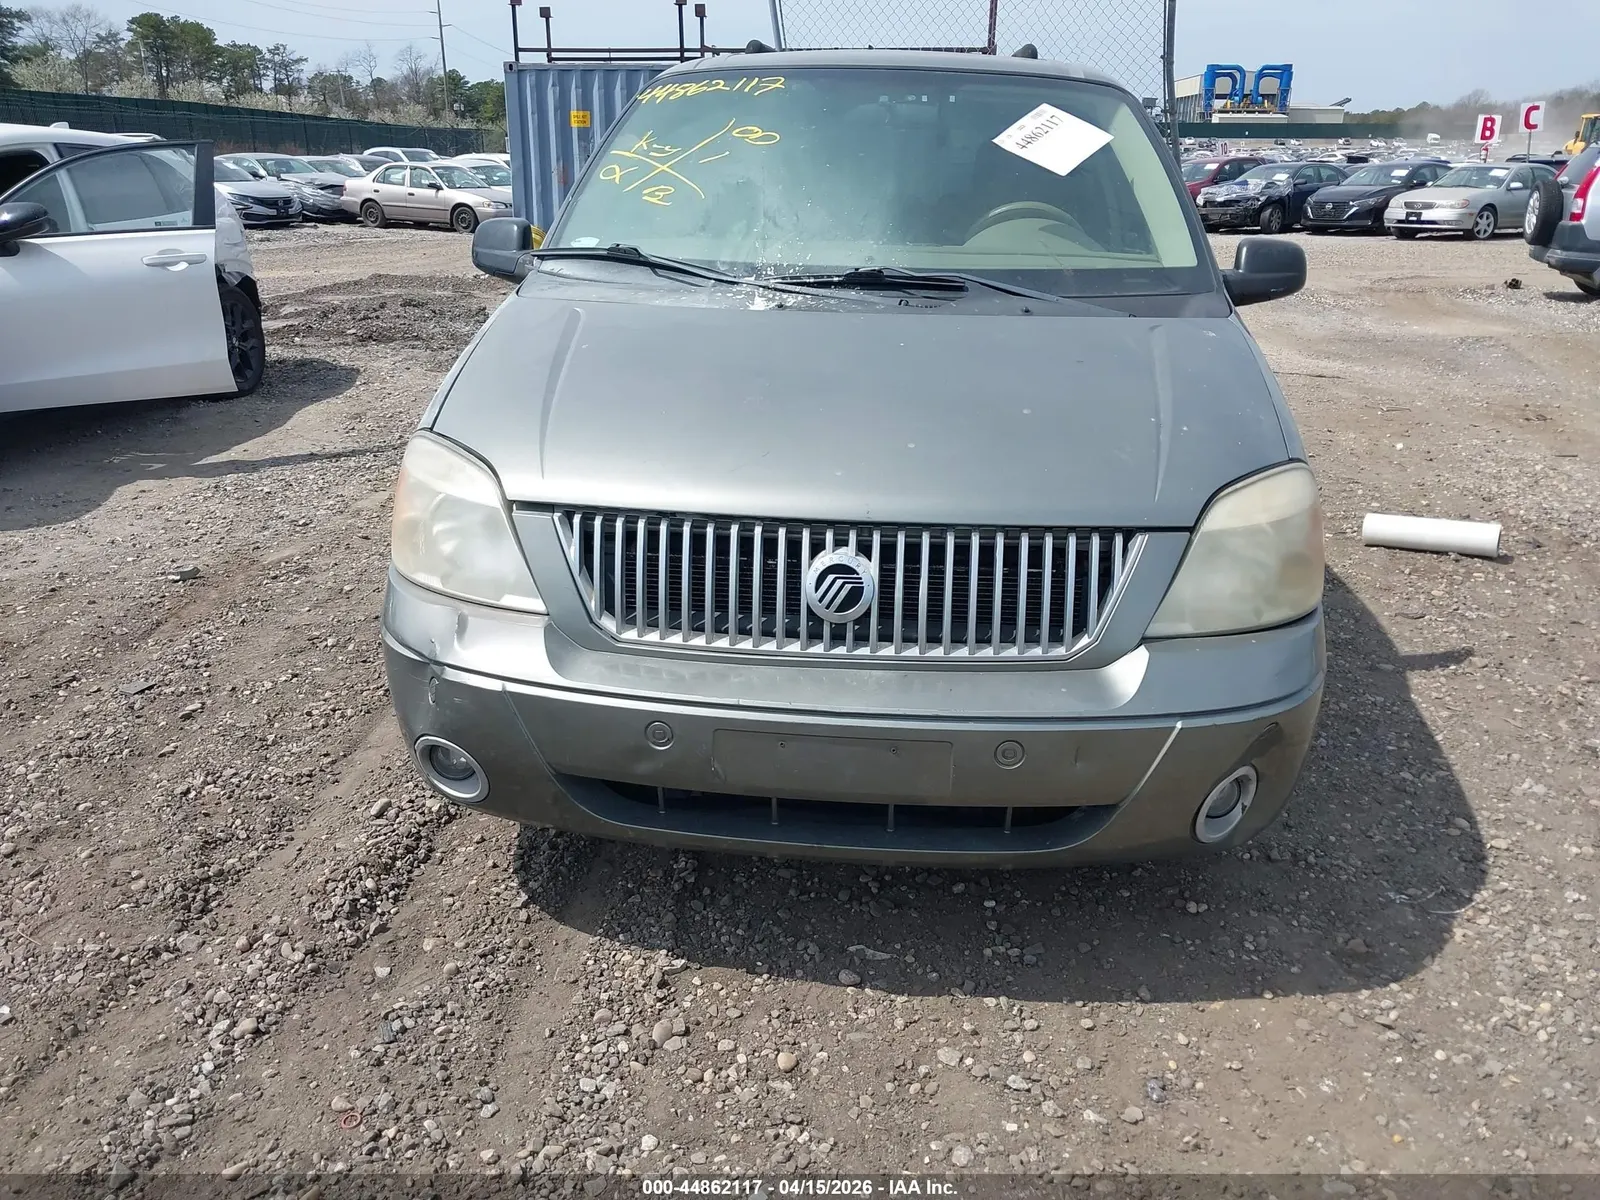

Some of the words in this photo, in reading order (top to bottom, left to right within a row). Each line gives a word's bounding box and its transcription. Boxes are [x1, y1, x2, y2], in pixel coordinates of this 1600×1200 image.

[637, 76, 785, 104] 44862117
[1480, 116, 1496, 141] B
[1523, 105, 1540, 130] C
[1015, 114, 1064, 150] 44862117
[1220, 142, 1228, 155] 10
[813, 555, 868, 575] MERCURY
